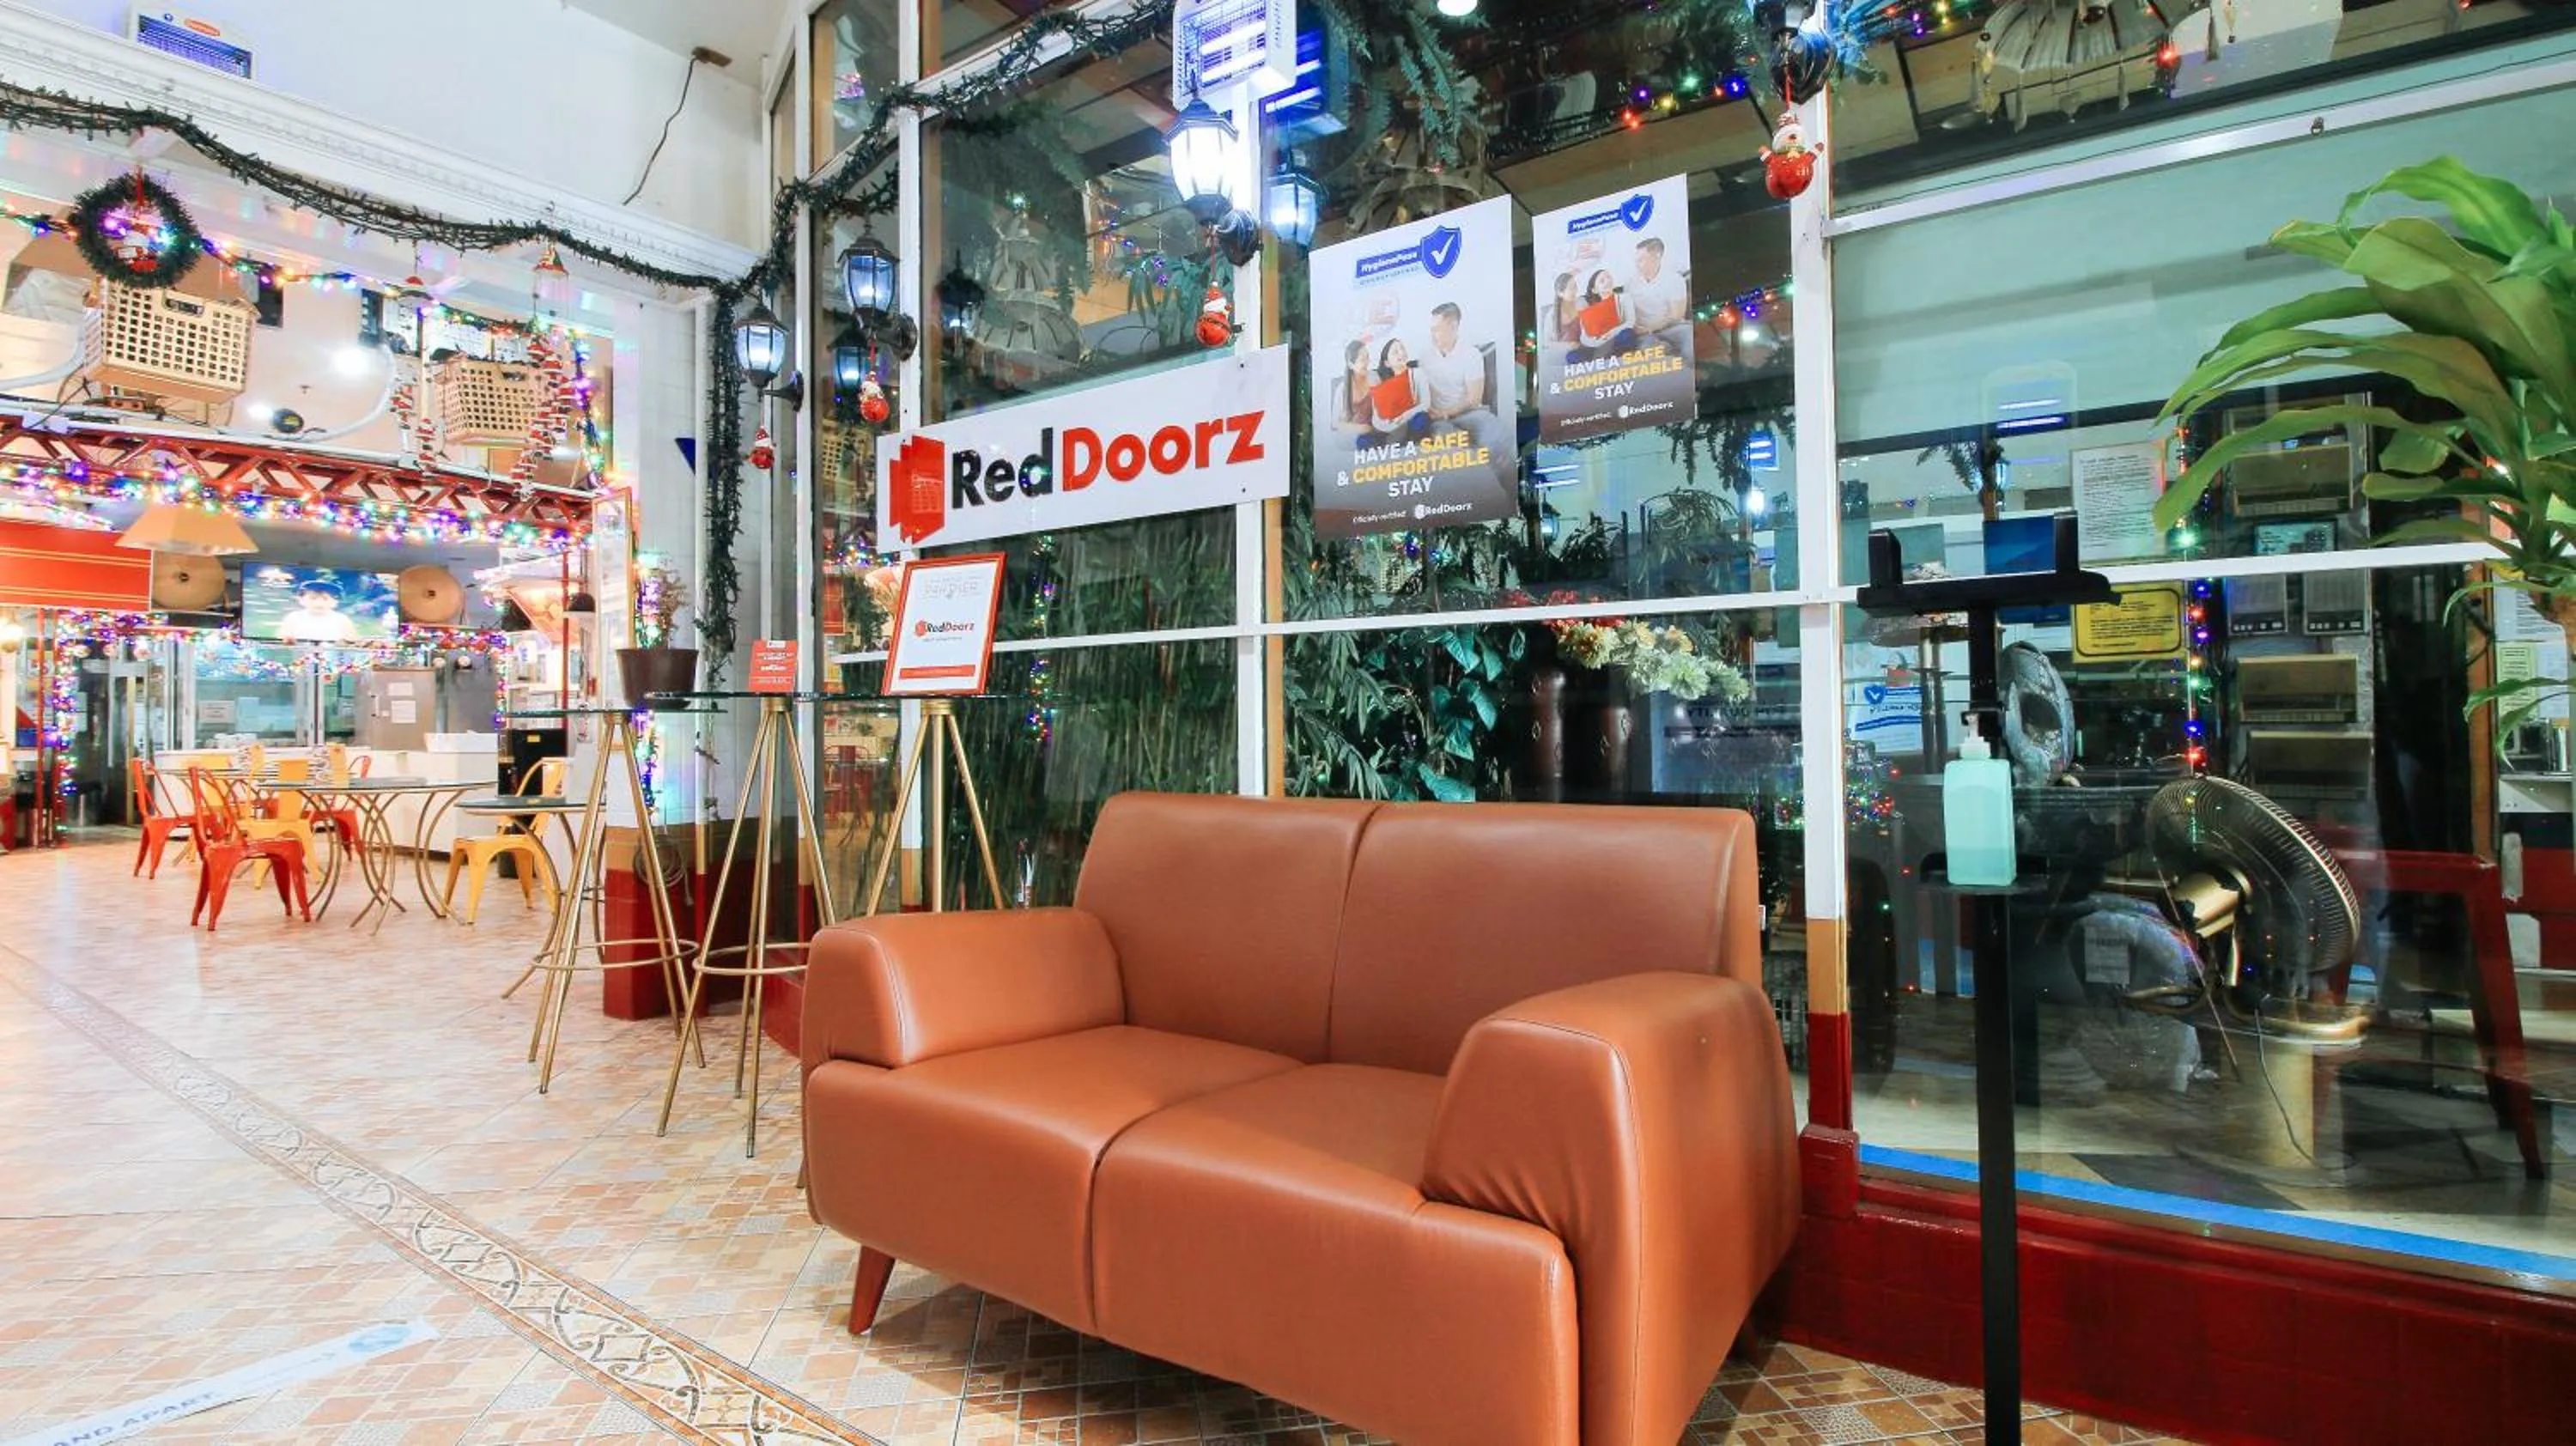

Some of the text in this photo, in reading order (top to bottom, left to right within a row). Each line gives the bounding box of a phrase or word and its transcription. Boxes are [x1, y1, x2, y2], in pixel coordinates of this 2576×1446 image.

[1550, 356, 1683, 394] & COMFORTABLE
[1564, 345, 1665, 377] HAVE A SAFE
[1595, 381, 1635, 399] STAY
[951, 410, 1265, 509] RedDoorz
[1354, 431, 1470, 465] HAVE A SAFE
[1337, 447, 1490, 487] & COMFORTABLE
[1388, 477, 1434, 497] STAY
[123, 1390, 216, 1428] APART
